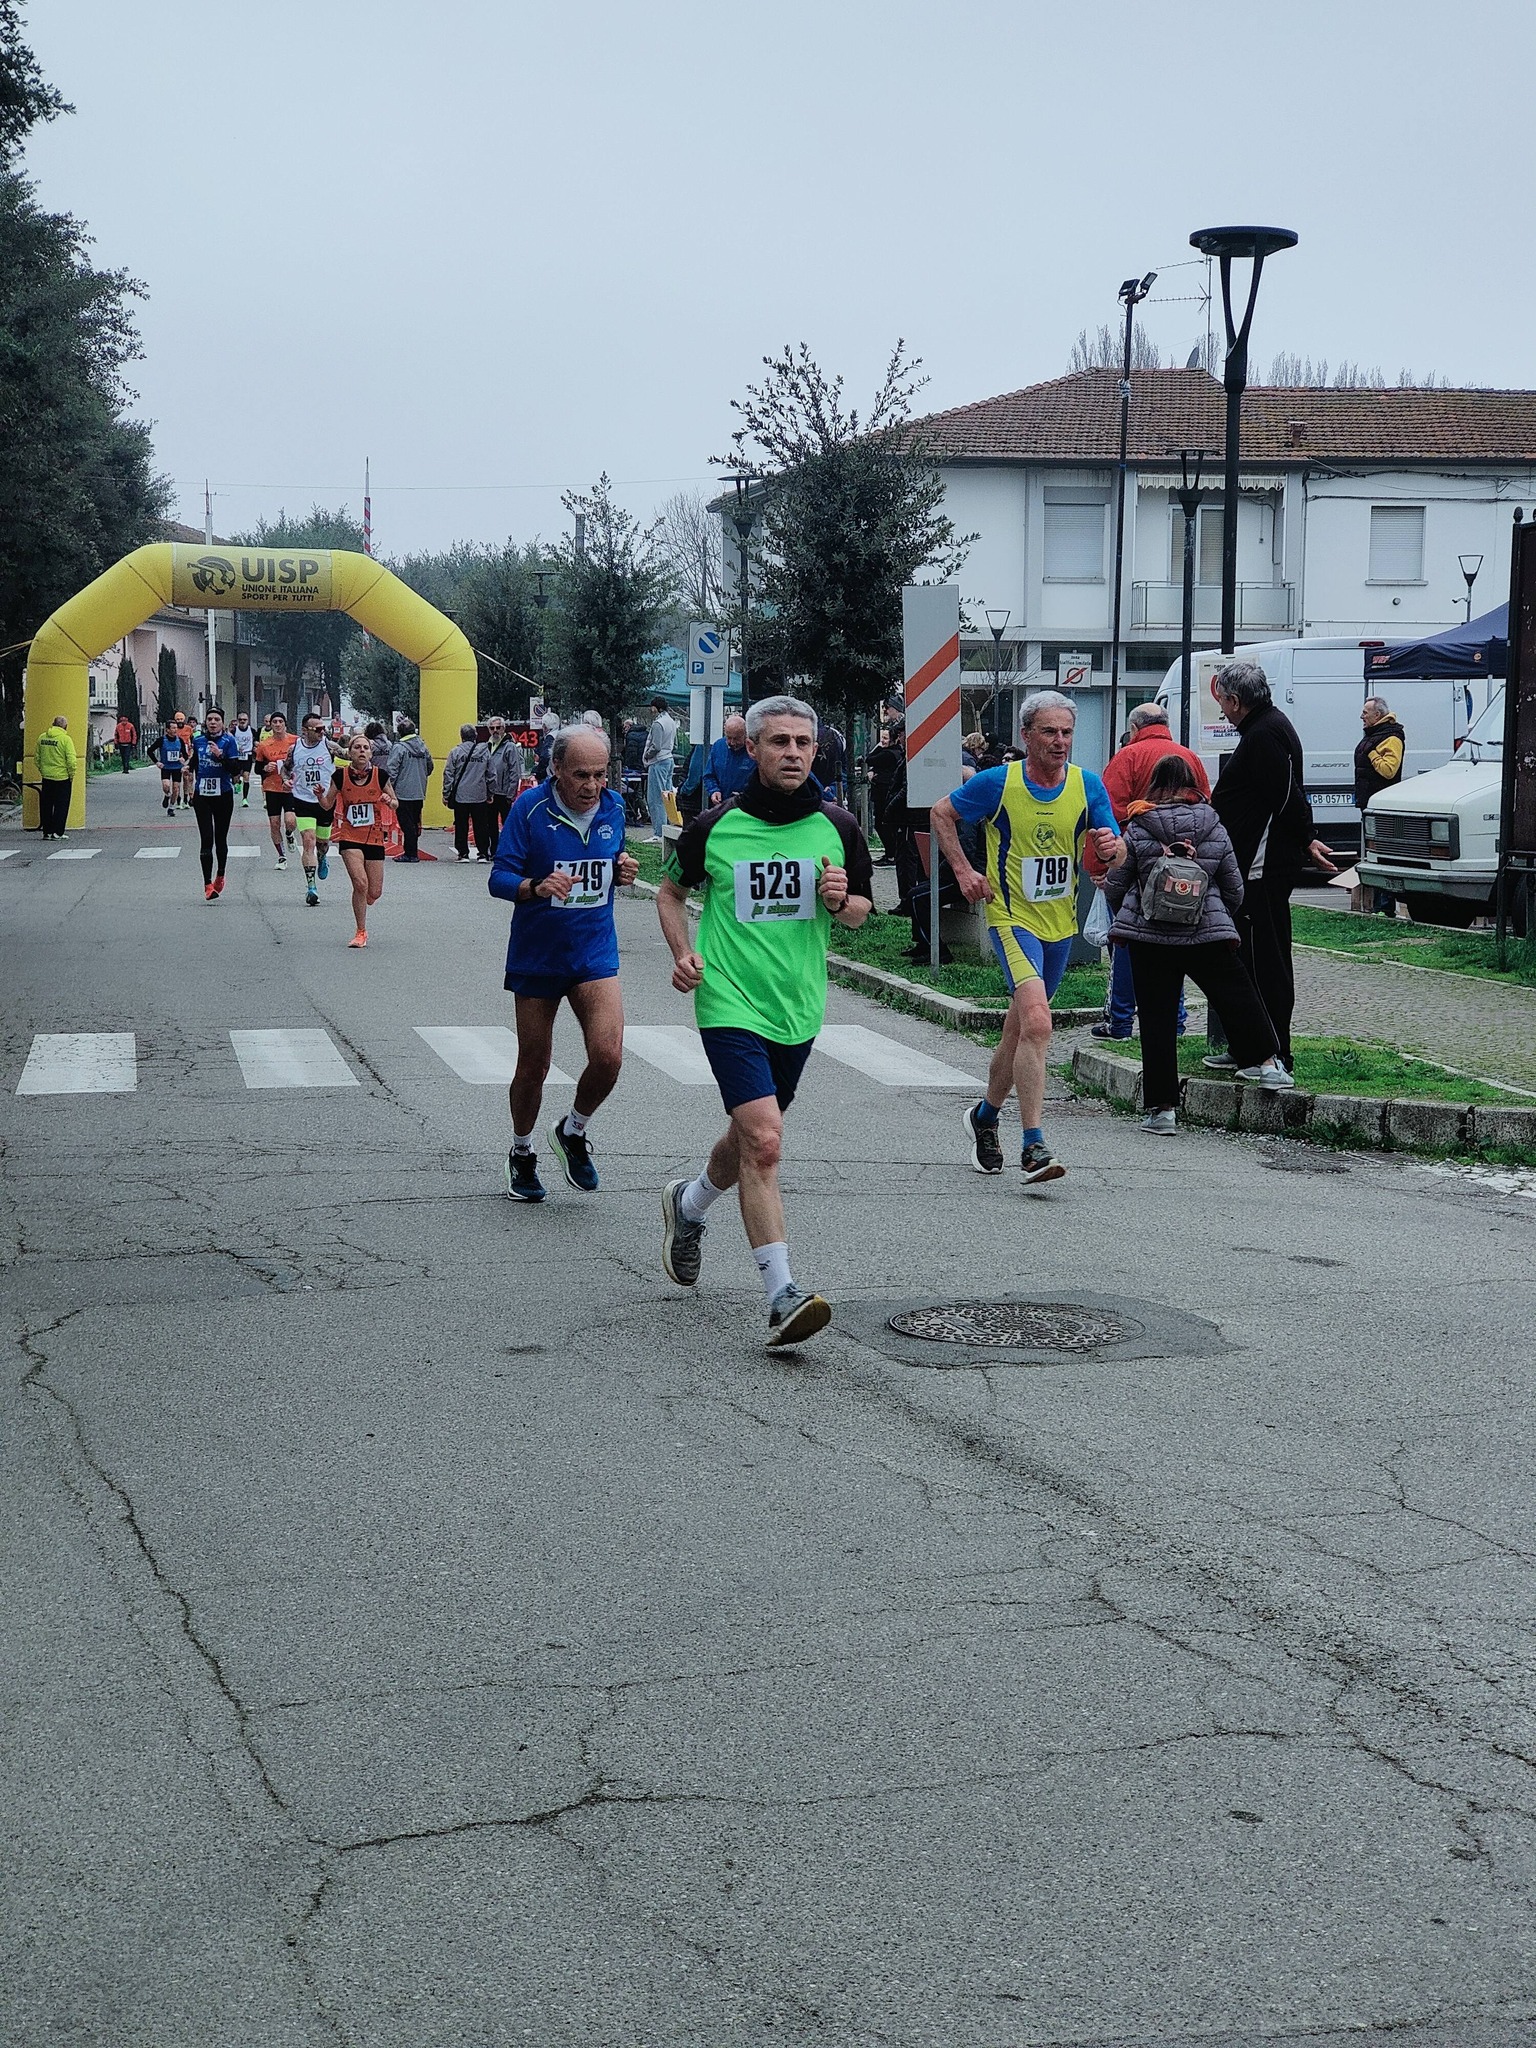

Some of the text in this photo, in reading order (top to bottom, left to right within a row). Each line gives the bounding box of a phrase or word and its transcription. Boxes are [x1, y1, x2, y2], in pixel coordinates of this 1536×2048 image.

[241, 557, 319, 584] UISP
[241, 584, 320, 594] UNIONE ITALIANA
[241, 592, 314, 602] SPORT PER TUTTI
[694, 662, 702, 672] P
[305, 770, 321, 783] 520
[1325, 794, 1352, 804] 057TP
[351, 804, 369, 820] 647
[568, 860, 604, 892] 749
[1034, 856, 1069, 887] 798
[749, 860, 801, 901] 523
